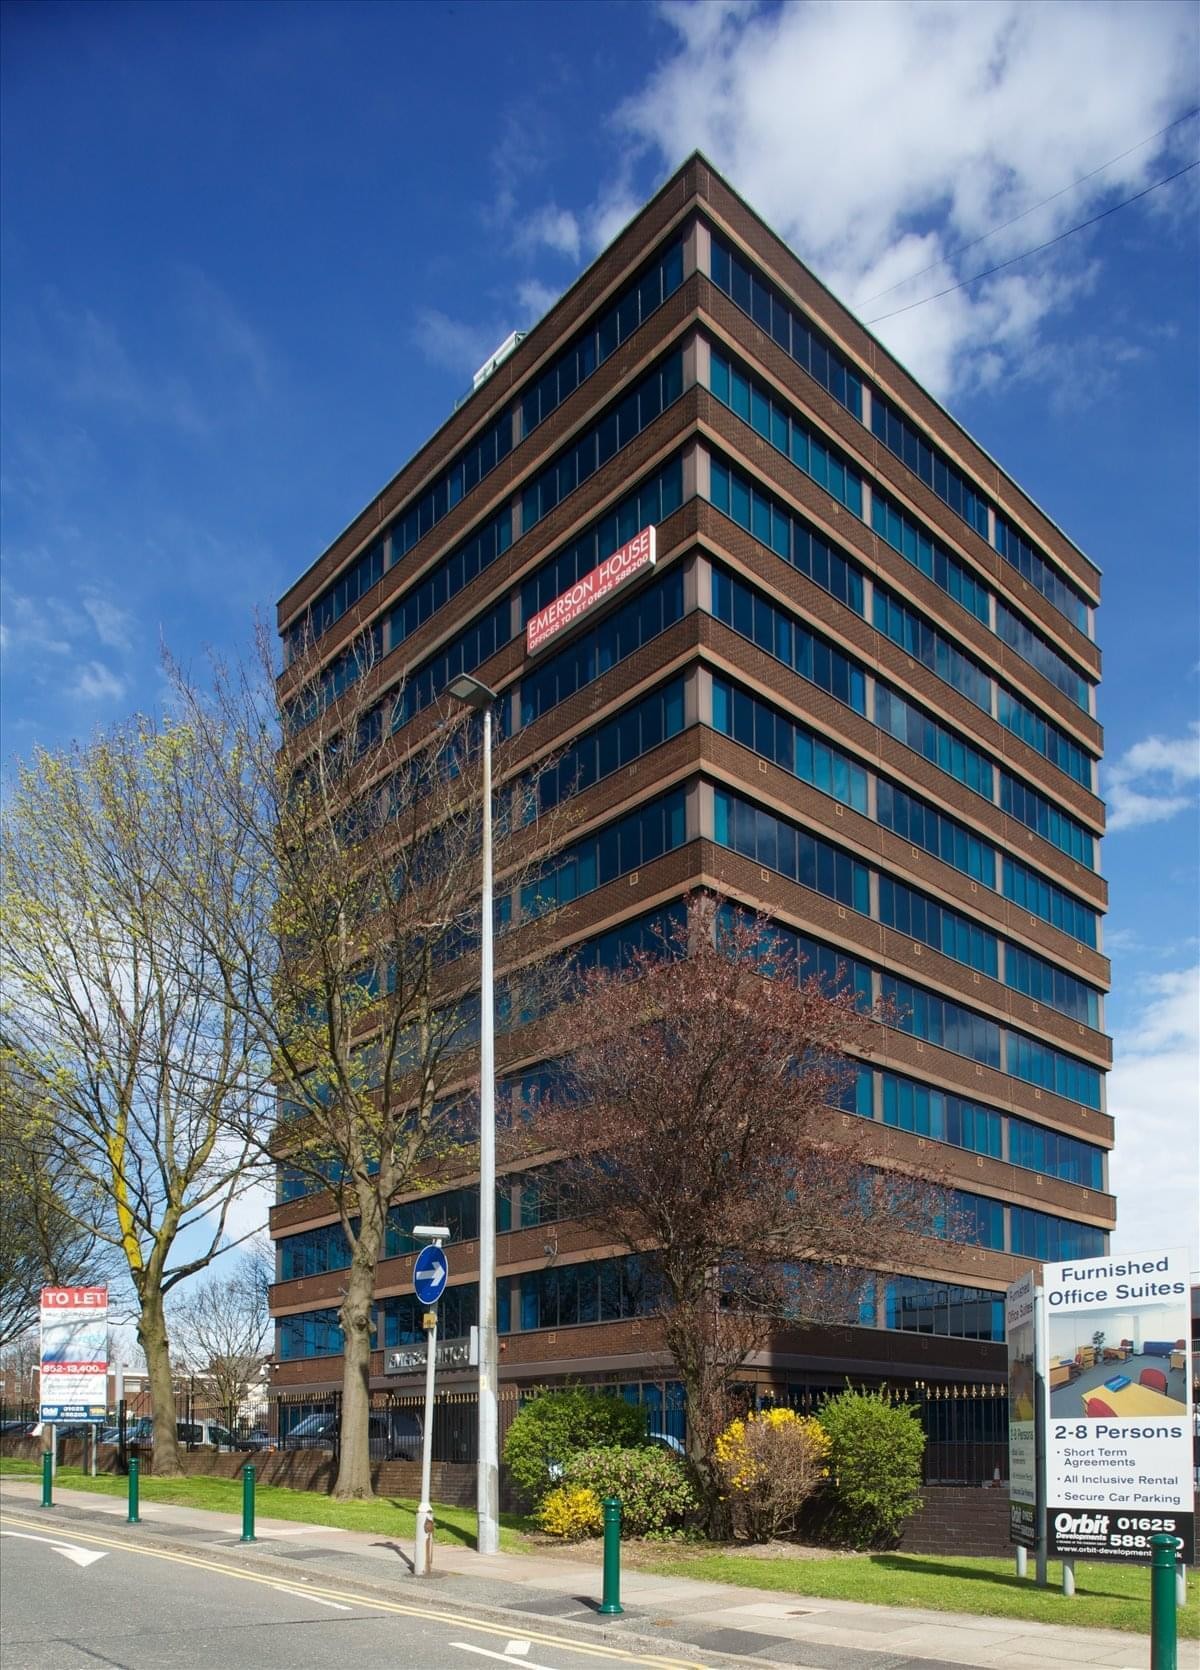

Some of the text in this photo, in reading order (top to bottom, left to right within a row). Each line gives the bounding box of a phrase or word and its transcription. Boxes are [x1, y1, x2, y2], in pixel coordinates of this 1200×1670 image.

[529, 531, 649, 638] EMERSON HOUSE
[529, 622, 560, 649] OFFICES
[561, 614, 571, 625] TO
[572, 600, 587, 618] LET
[1062, 1257, 1169, 1282] Furnished
[45, 1292, 104, 1305] TO LET
[1049, 1282, 1185, 1306] Office Suites
[1055, 1425, 1183, 1440] 2-8 Persons
[1064, 1448, 1128, 1457] Short Term
[1064, 1458, 1136, 1468] Agreements
[1064, 1475, 1179, 1485] All Inclusive Rental
[1064, 1492, 1182, 1506] Secure Car Parking
[1054, 1513, 1110, 1534] Orbit
[1117, 1517, 1176, 1532] 01625
[1055, 1532, 1107, 1542] Developments
[1110, 1534, 1185, 1550] 5880
